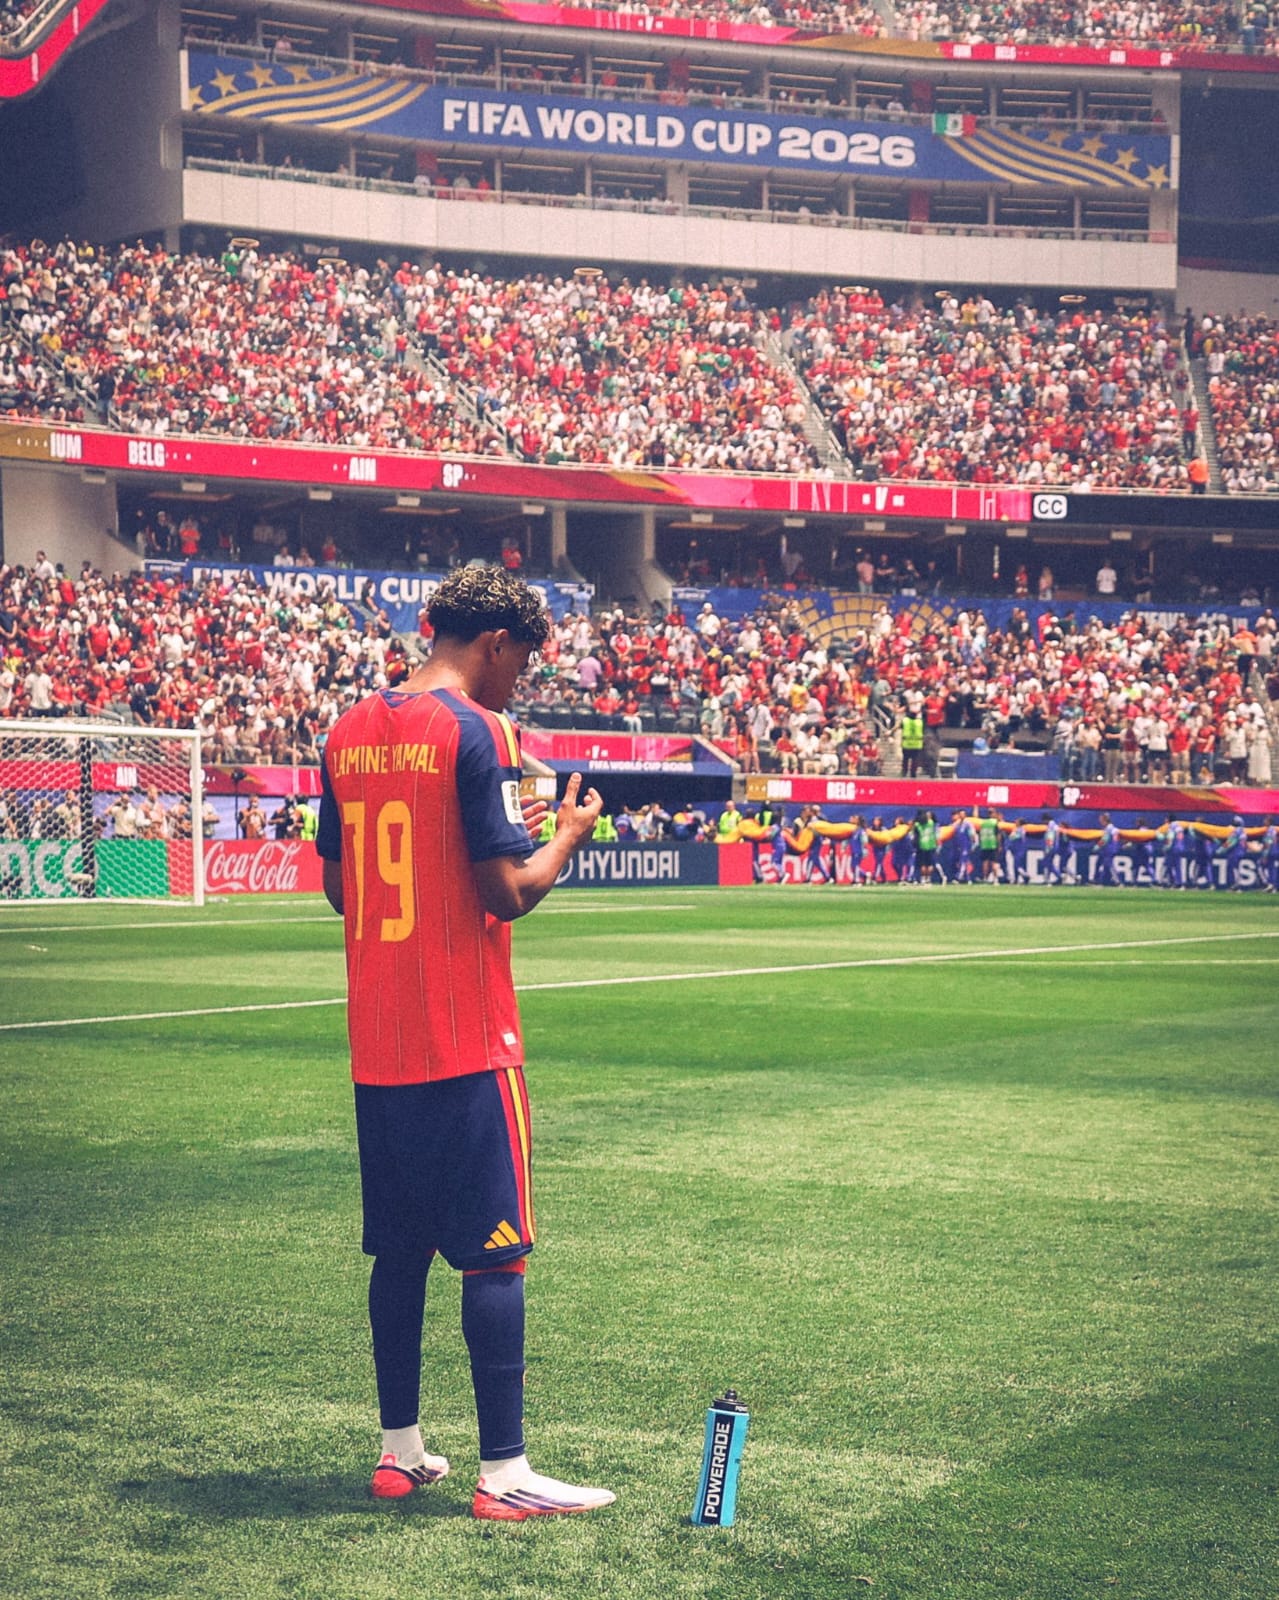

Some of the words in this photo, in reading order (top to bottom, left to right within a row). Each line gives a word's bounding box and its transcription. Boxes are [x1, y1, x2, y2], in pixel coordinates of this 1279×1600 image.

[443, 99, 532, 137] FIFA
[536, 106, 686, 148] WORLD
[691, 119, 772, 155] CUP
[778, 126, 917, 168] 2026
[128, 440, 165, 467] BELG
[1037, 500, 1063, 515] CC
[333, 745, 388, 778] LAMINE
[392, 743, 439, 775] YAMAL
[204, 841, 303, 893] Coca-Cola
[342, 800, 415, 942] 19
[578, 850, 680, 880] HYUNDAI
[704, 1422, 730, 1518] POWERADE
